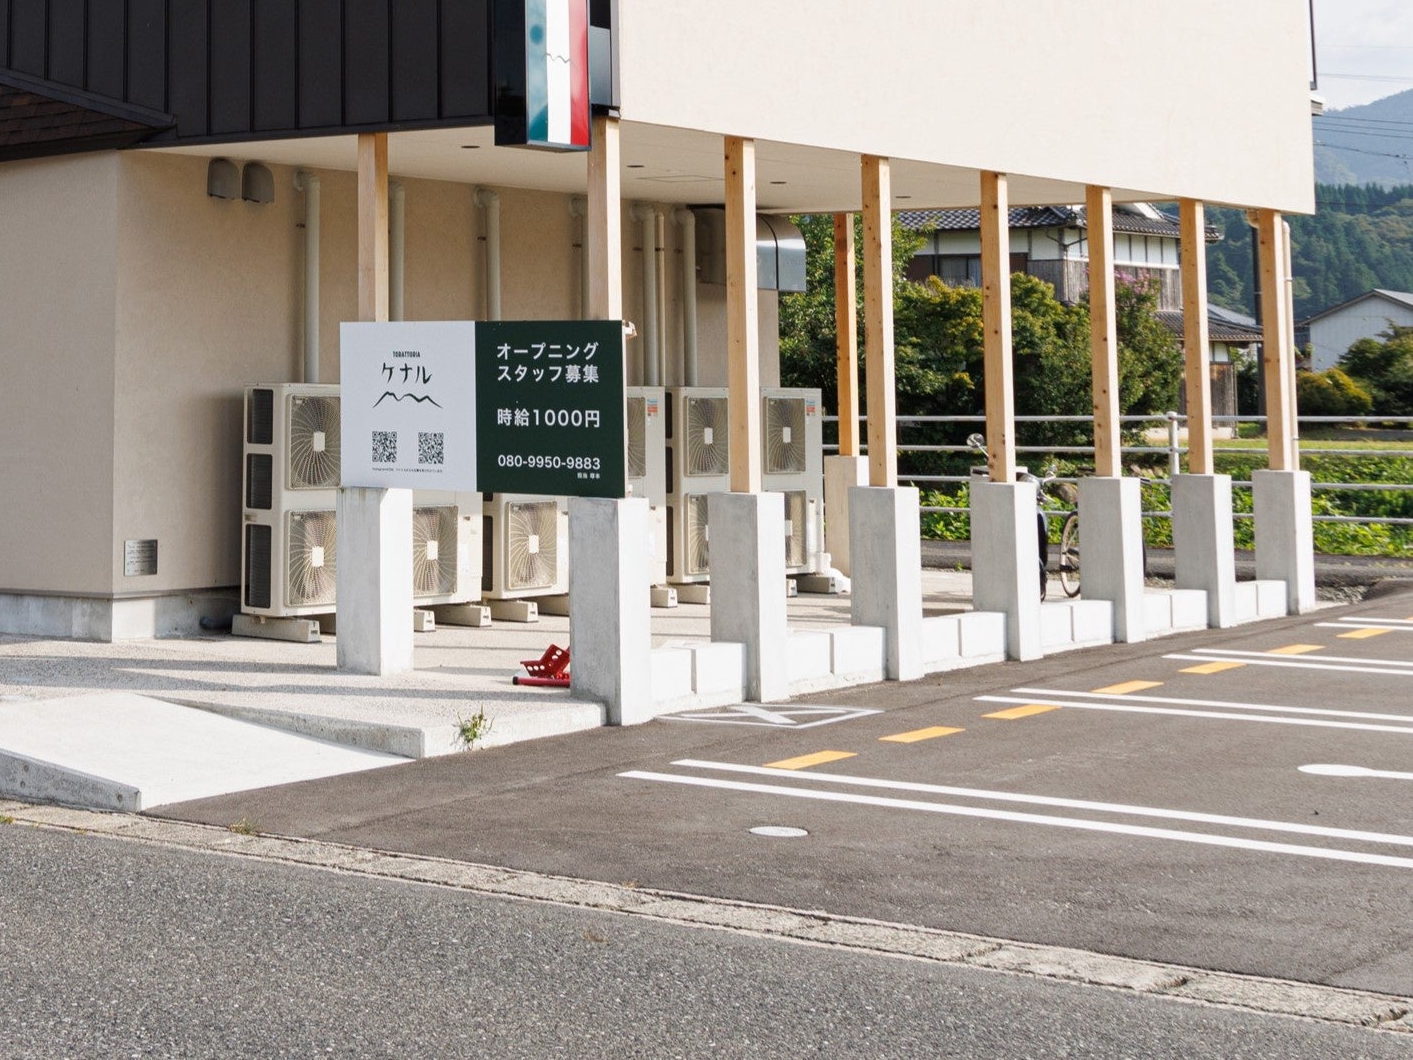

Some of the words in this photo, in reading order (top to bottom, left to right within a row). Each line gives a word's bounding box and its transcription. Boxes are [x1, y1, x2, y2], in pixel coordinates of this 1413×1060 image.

[393, 350, 421, 358] TORATTORIA
[497, 342, 599, 360] オープニング
[382, 362, 433, 384] ケナル
[497, 364, 599, 383] スタッフ募集
[497, 408, 600, 428] 時給1000円
[498, 454, 601, 470] 080-9950-9883
